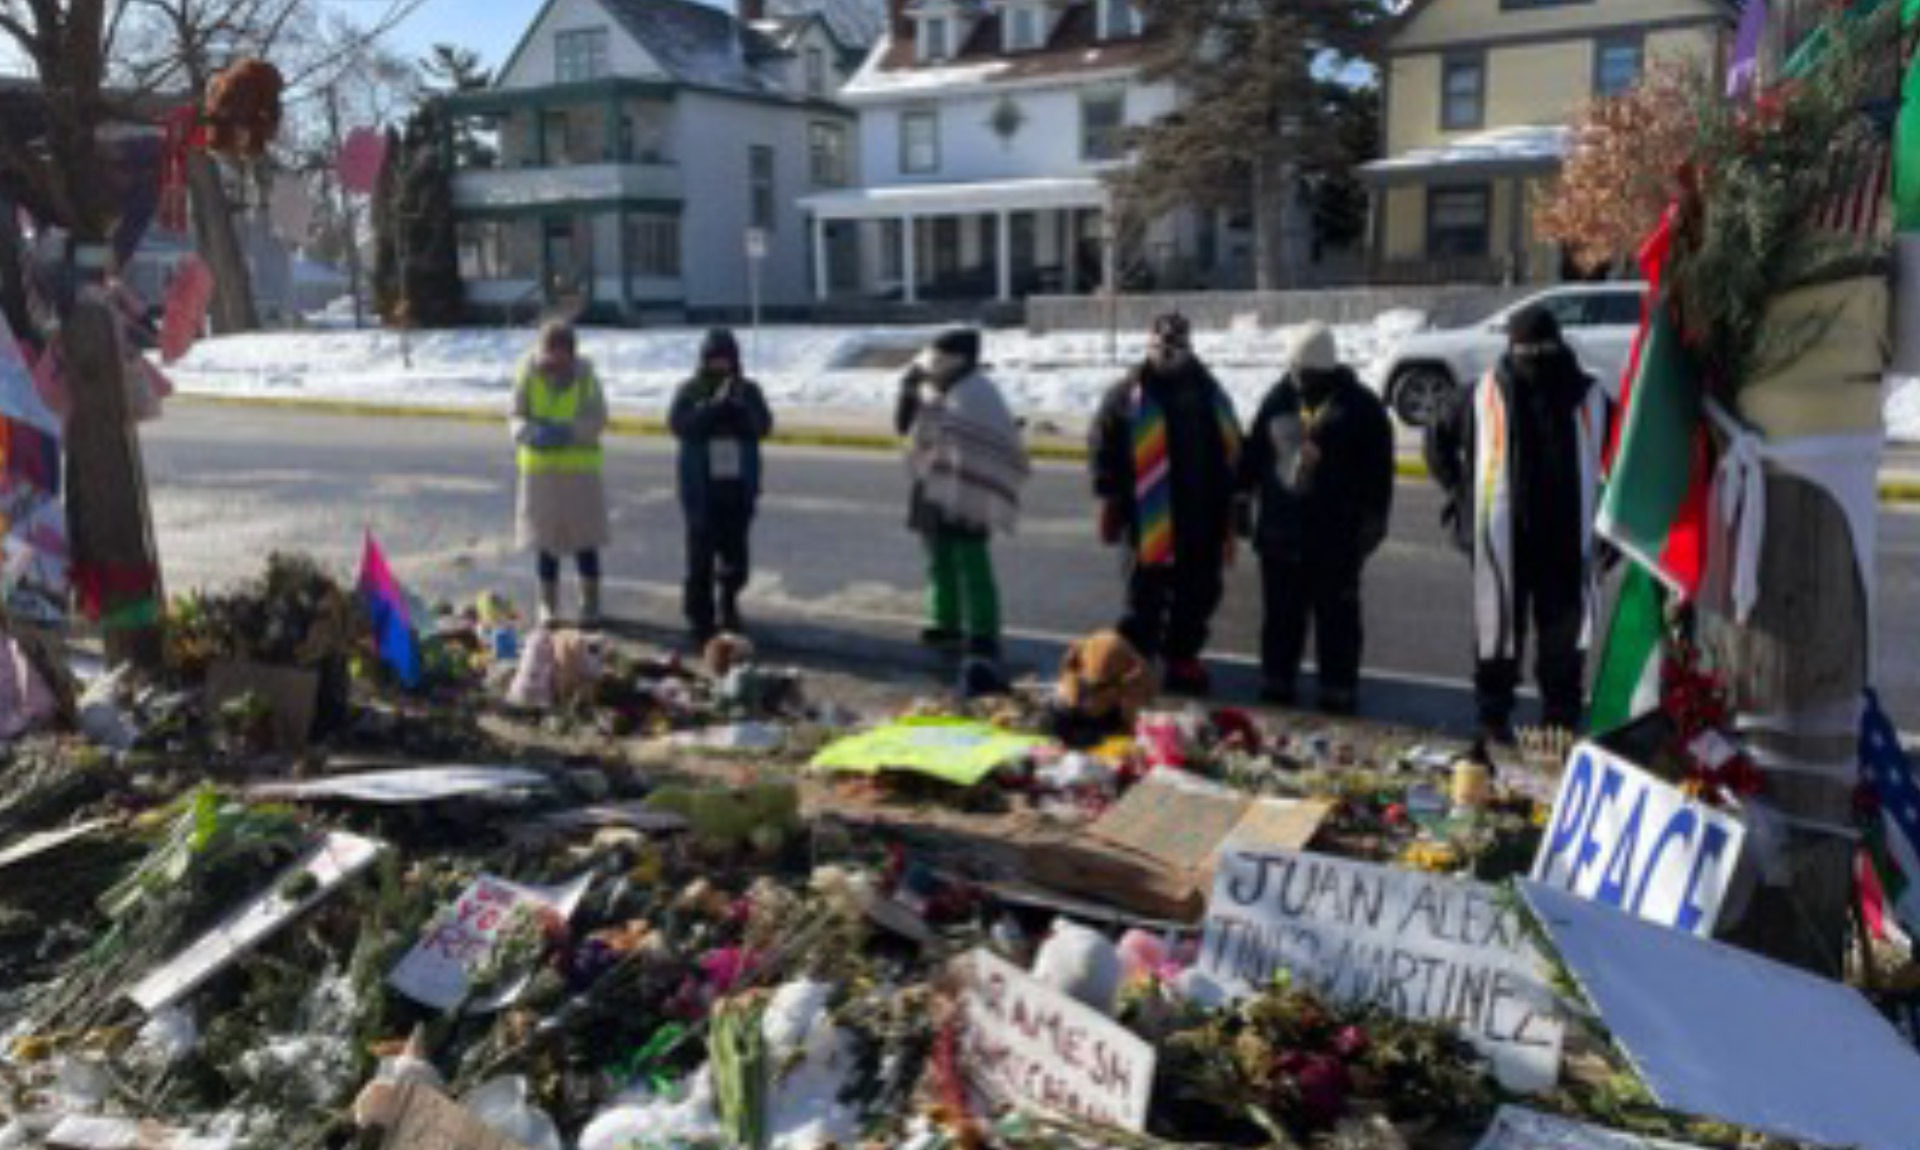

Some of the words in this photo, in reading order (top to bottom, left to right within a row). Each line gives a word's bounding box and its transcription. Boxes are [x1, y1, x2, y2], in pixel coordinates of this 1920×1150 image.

[1227, 853, 1383, 927] JUAN
[1399, 880, 1520, 953] ALEX
[1543, 753, 1728, 932] PEACE
